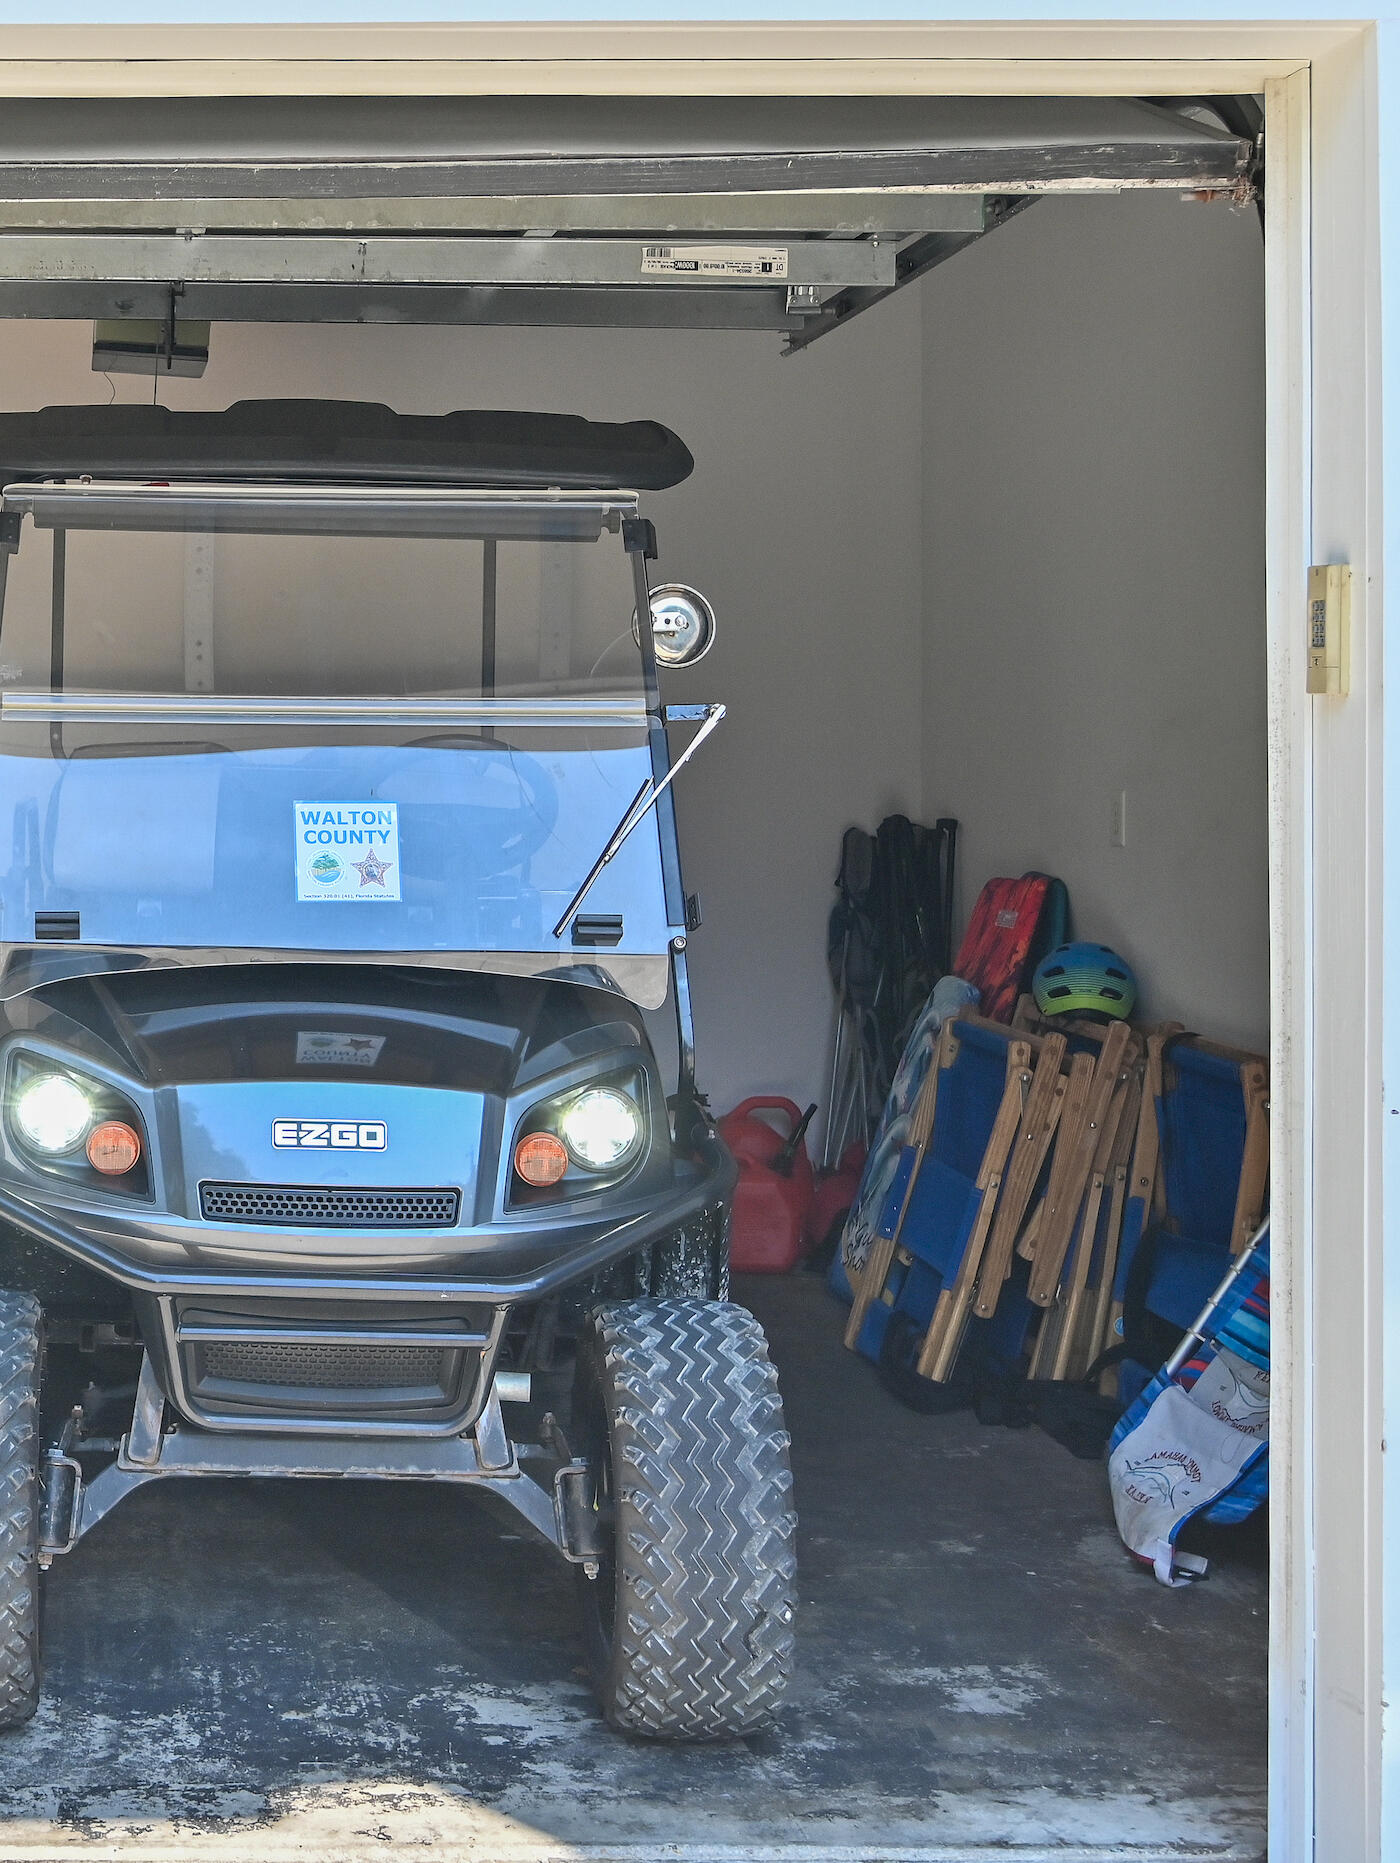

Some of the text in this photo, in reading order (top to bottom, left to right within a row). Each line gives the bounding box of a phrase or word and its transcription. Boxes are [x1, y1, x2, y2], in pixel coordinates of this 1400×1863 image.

[300, 810, 392, 825] WALTON
[303, 829, 391, 844] COUNTY
[273, 1121, 386, 1149] EZGO
